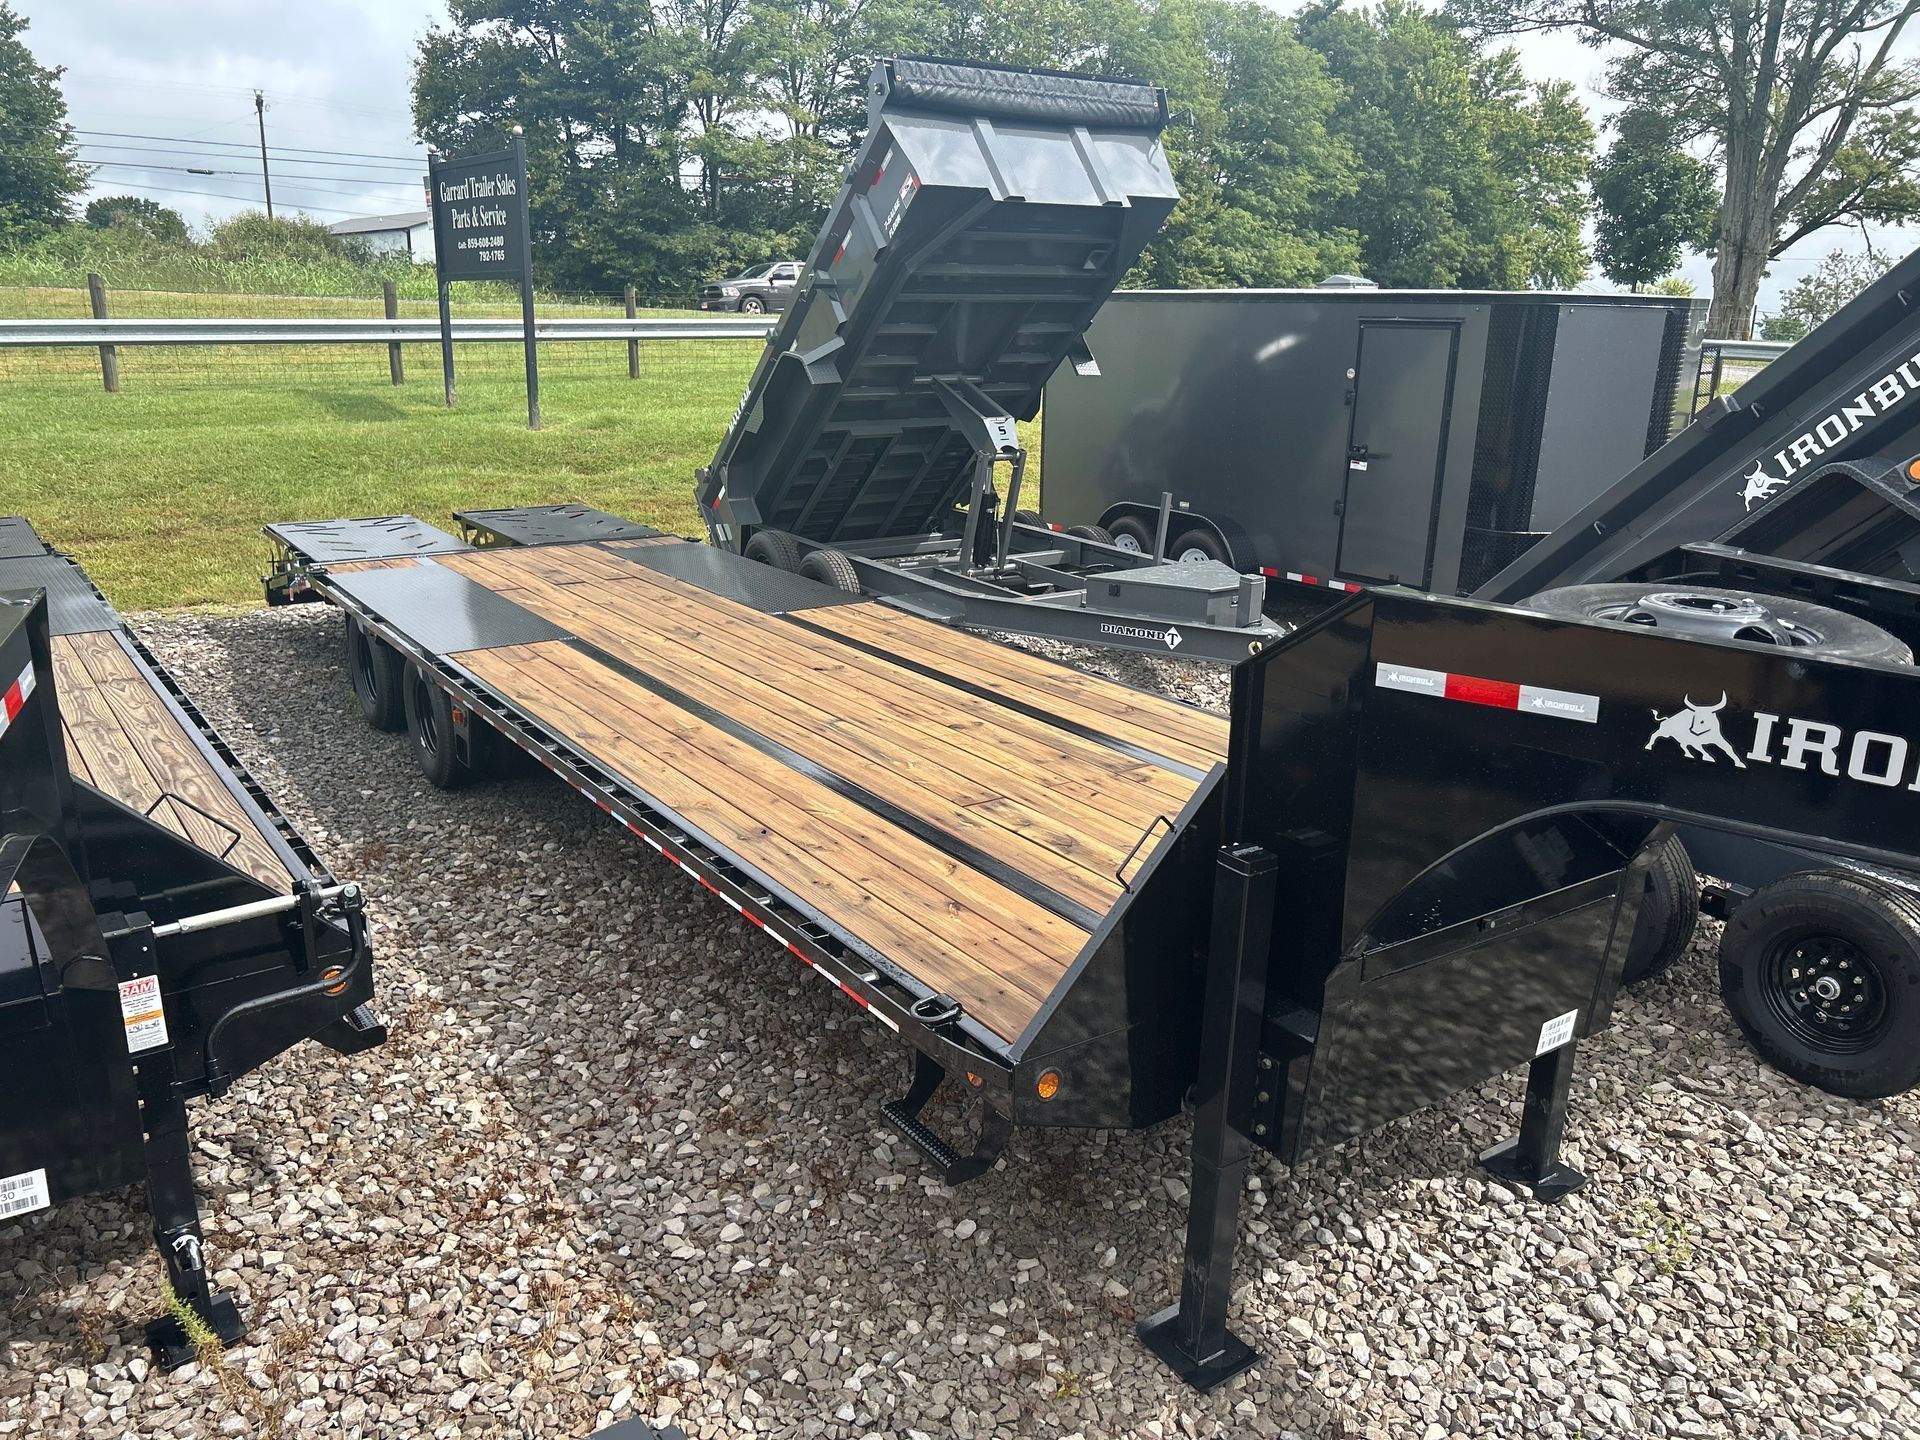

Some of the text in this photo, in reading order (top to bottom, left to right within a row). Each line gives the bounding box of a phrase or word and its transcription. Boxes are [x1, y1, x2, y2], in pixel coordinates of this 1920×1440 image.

[440, 173, 517, 203] Garrard Trailer Sales
[451, 204, 507, 229] Parts & Service
[479, 250, 505, 262] 792-1765
[1100, 622, 1166, 641] DIAMOND
[1398, 674, 1435, 687] IRONBULL
[1544, 699, 1585, 714] IRONBULL
[1746, 711, 1920, 792] IRO
[120, 980, 155, 998] RAM
